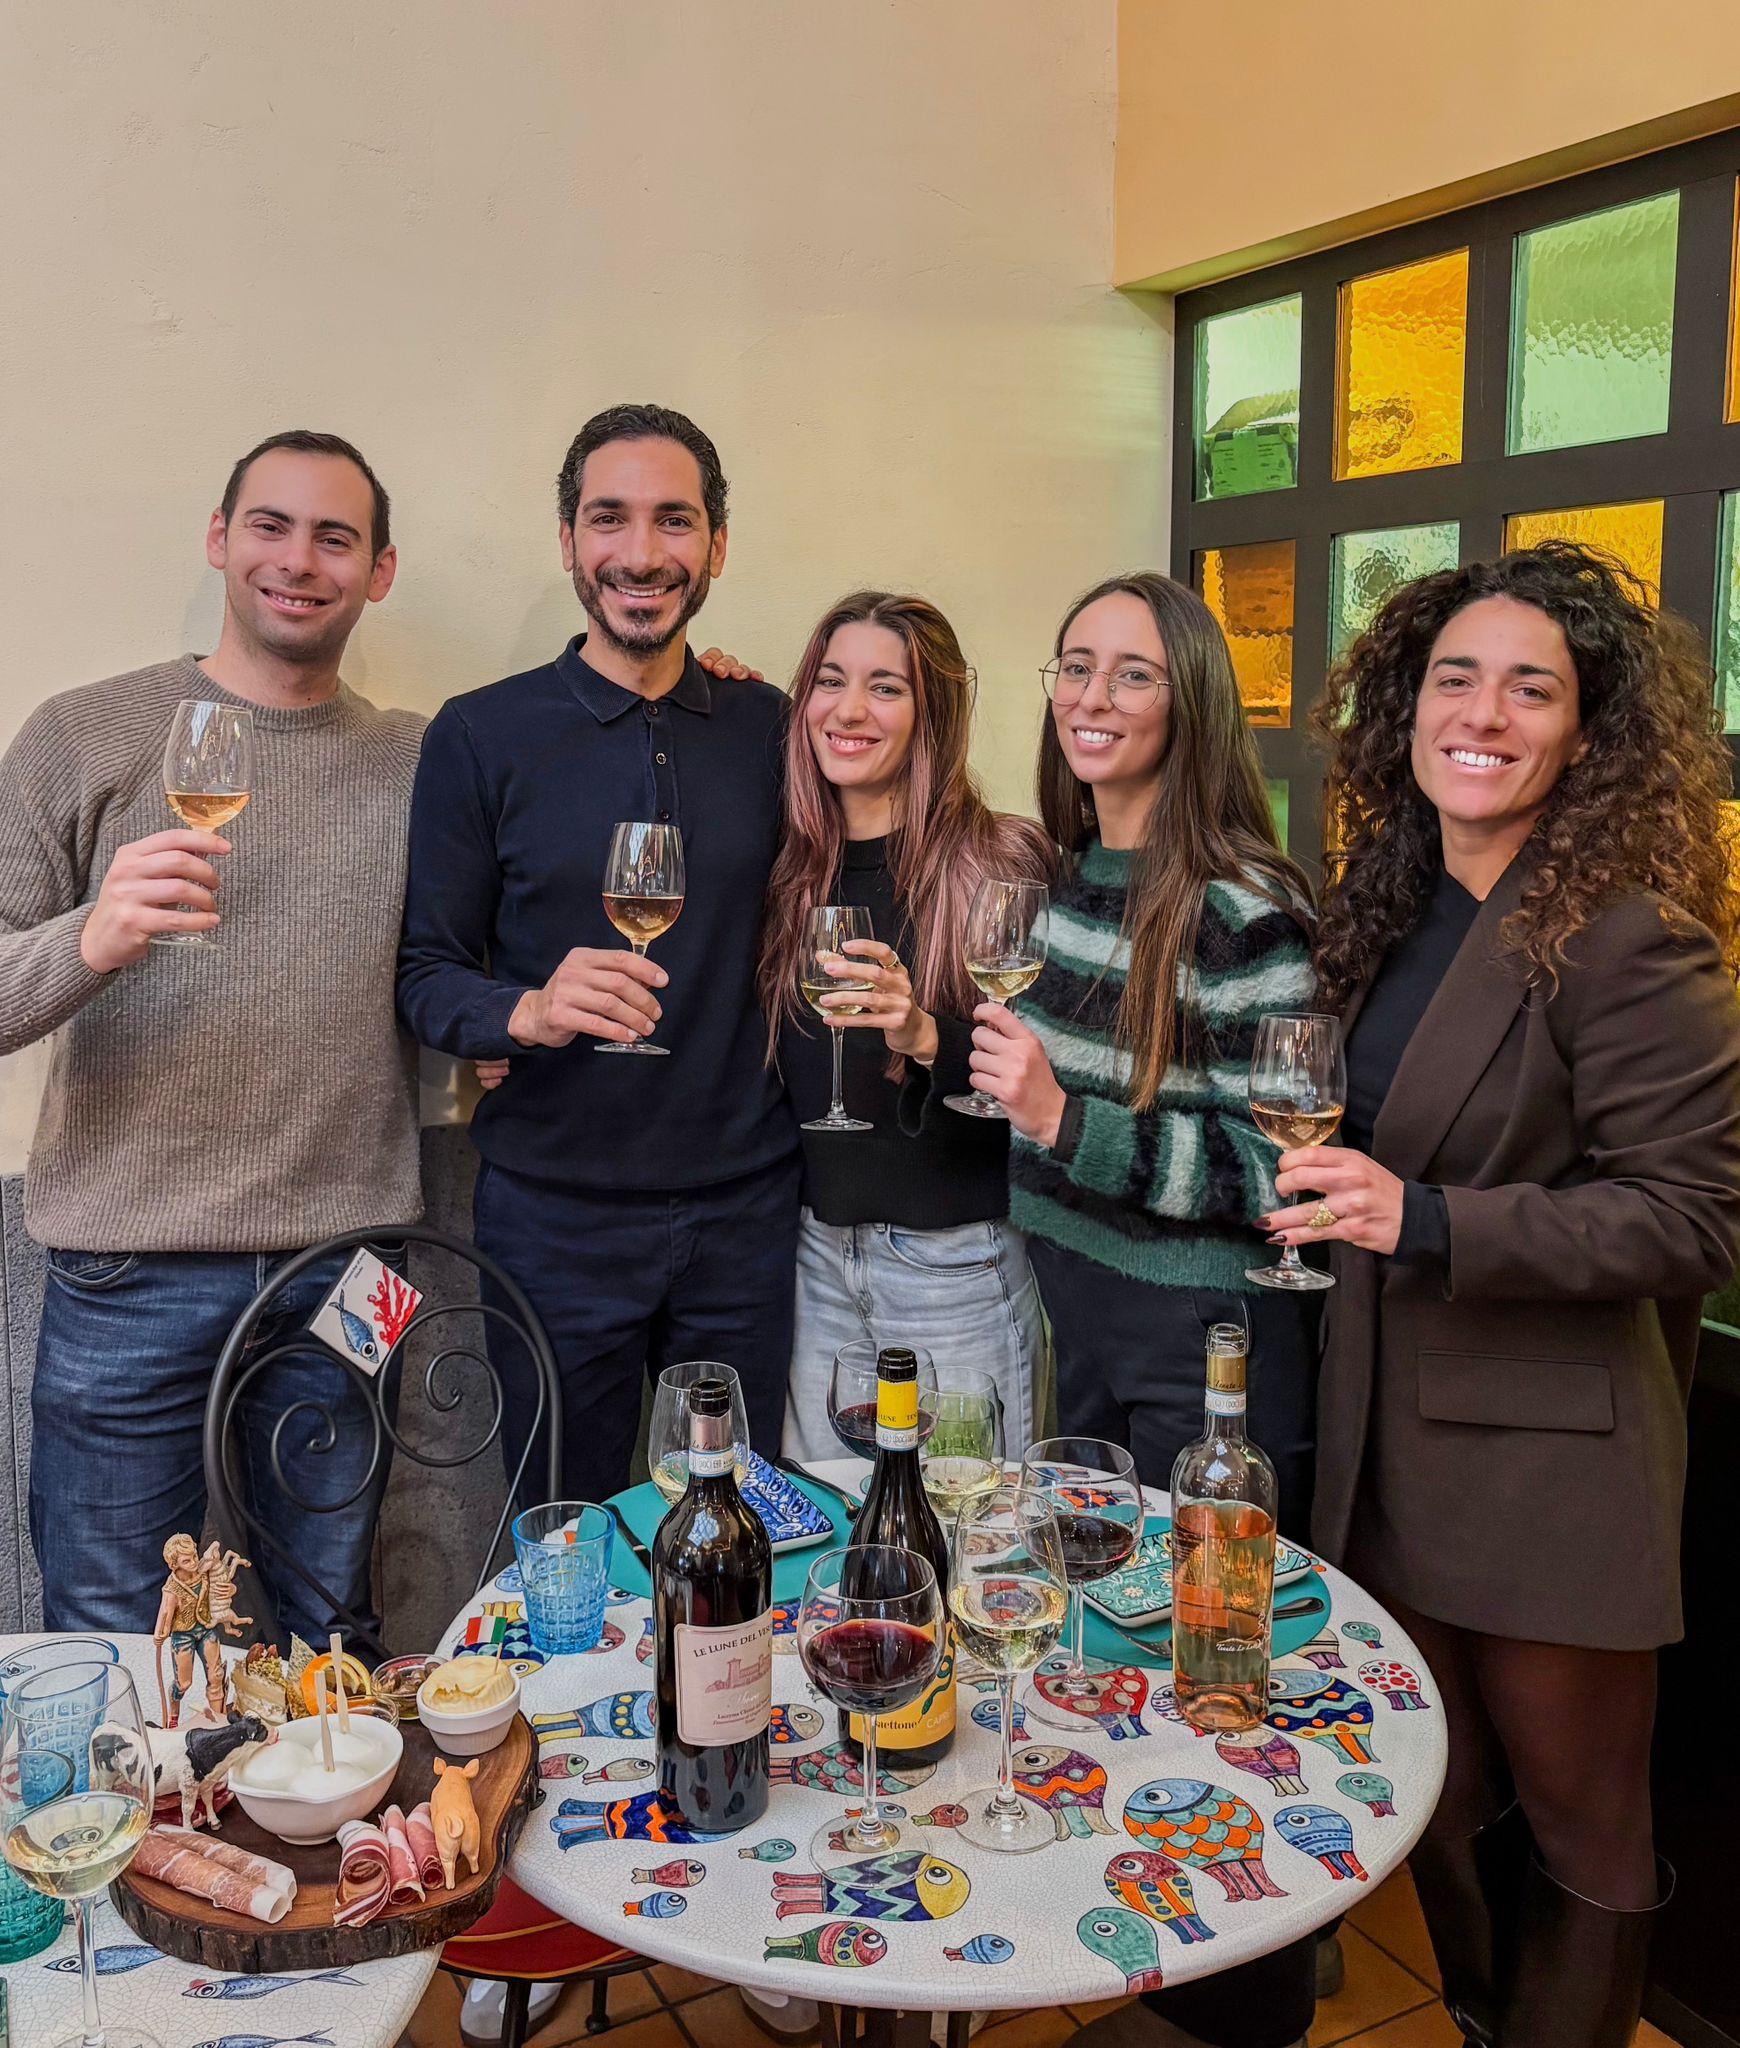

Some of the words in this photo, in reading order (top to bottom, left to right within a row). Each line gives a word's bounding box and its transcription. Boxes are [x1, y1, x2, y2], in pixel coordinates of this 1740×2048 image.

[693, 1648, 707, 1658] LE
[708, 1640, 738, 1654] LUNE
[740, 1633, 757, 1646] DEL
